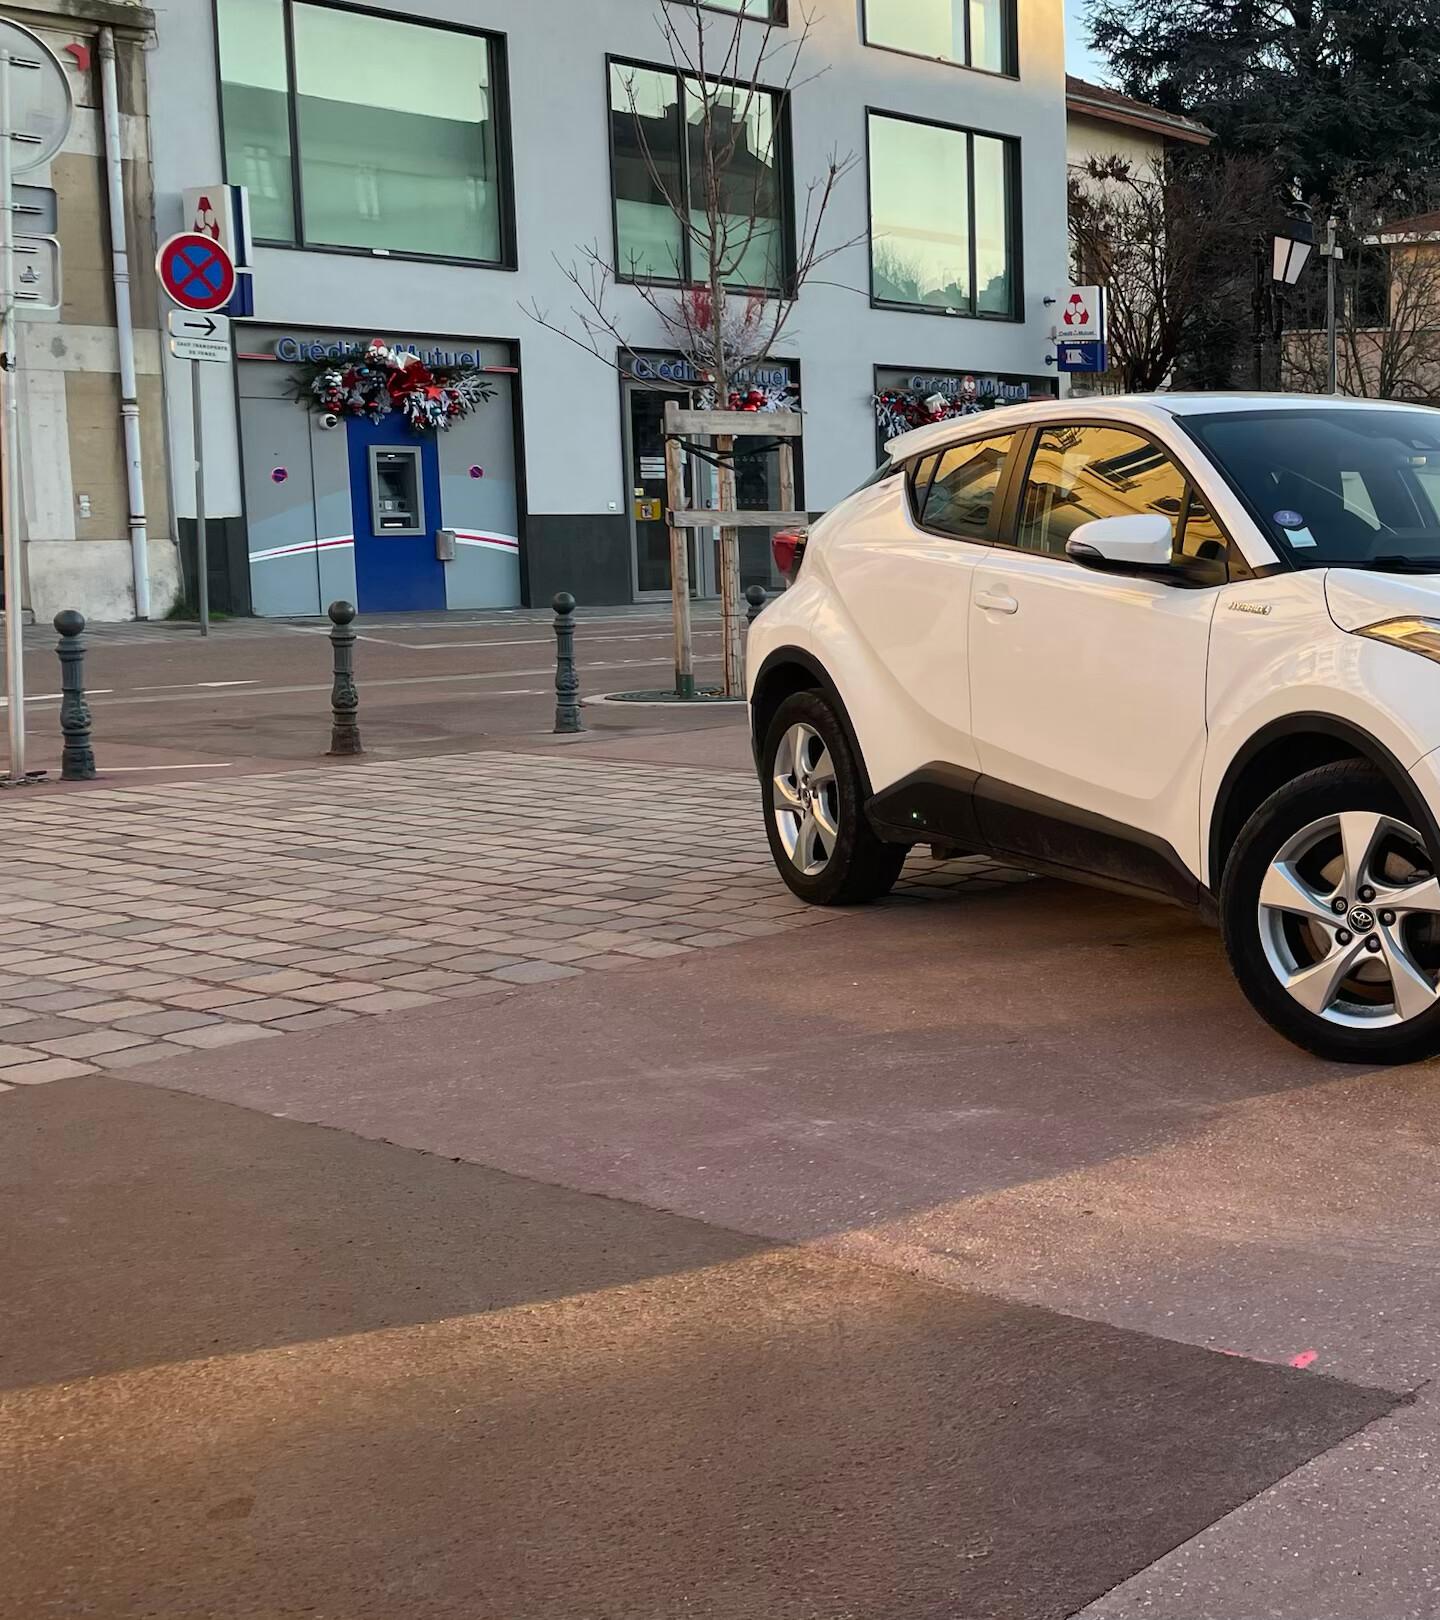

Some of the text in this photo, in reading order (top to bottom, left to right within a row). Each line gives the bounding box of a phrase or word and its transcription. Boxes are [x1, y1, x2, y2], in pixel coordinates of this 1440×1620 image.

[277, 336, 480, 370] Crédit Mutuel
[912, 375, 1030, 401] Crédit Mutuel
